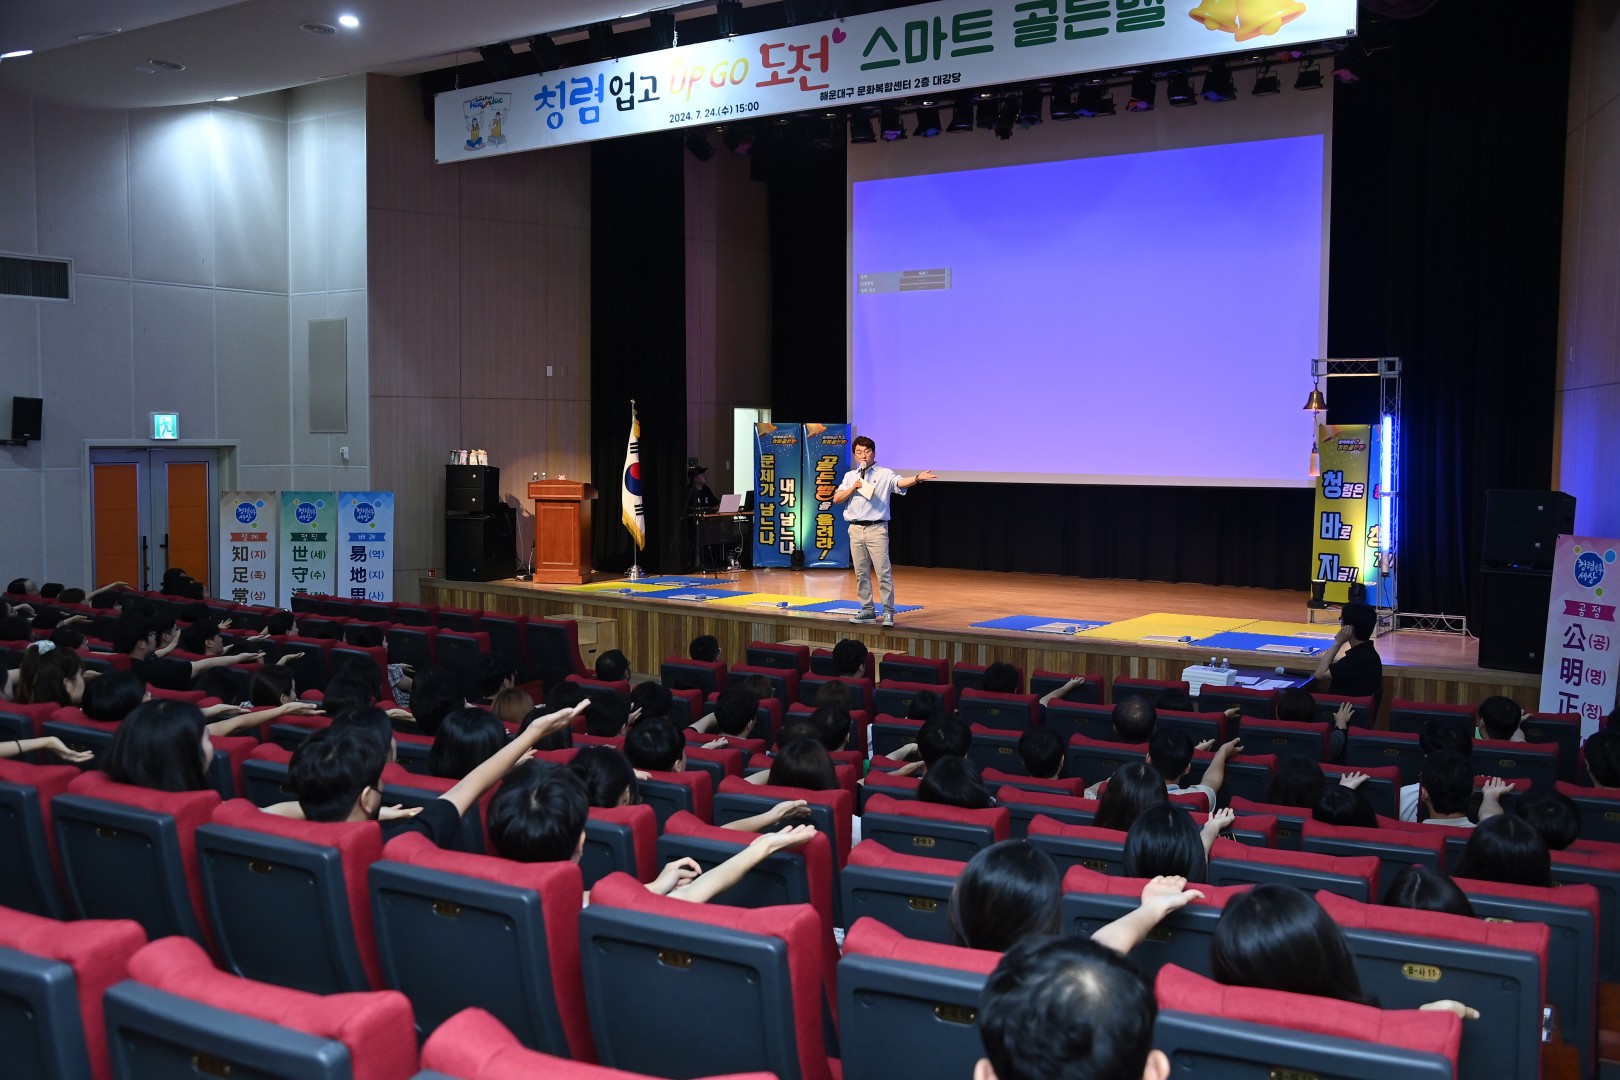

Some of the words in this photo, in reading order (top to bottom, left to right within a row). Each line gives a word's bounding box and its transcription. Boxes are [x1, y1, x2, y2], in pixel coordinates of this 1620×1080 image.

[533, 73, 604, 129] 청렴
[609, 71, 660, 112] 업고
[669, 58, 705, 103] UP
[709, 57, 749, 88] GO
[755, 34, 830, 92] 도전
[860, 8, 995, 71] 스마트
[819, 87, 855, 102] 해운대구
[857, 79, 912, 97] 문화복합센터
[914, 77, 930, 89] 2층
[932, 72, 962, 86] 대강당
[735, 101, 760, 113] 15:00
[758, 453, 776, 497] 문제가
[1322, 470, 1365, 499] 청렴은
[778, 477, 796, 507] 내가
[758, 501, 776, 546] 남느냐
[1320, 511, 1353, 541] 바로
[1317, 553, 1360, 583] 지금!!
[1578, 603, 1601, 618] 공정
